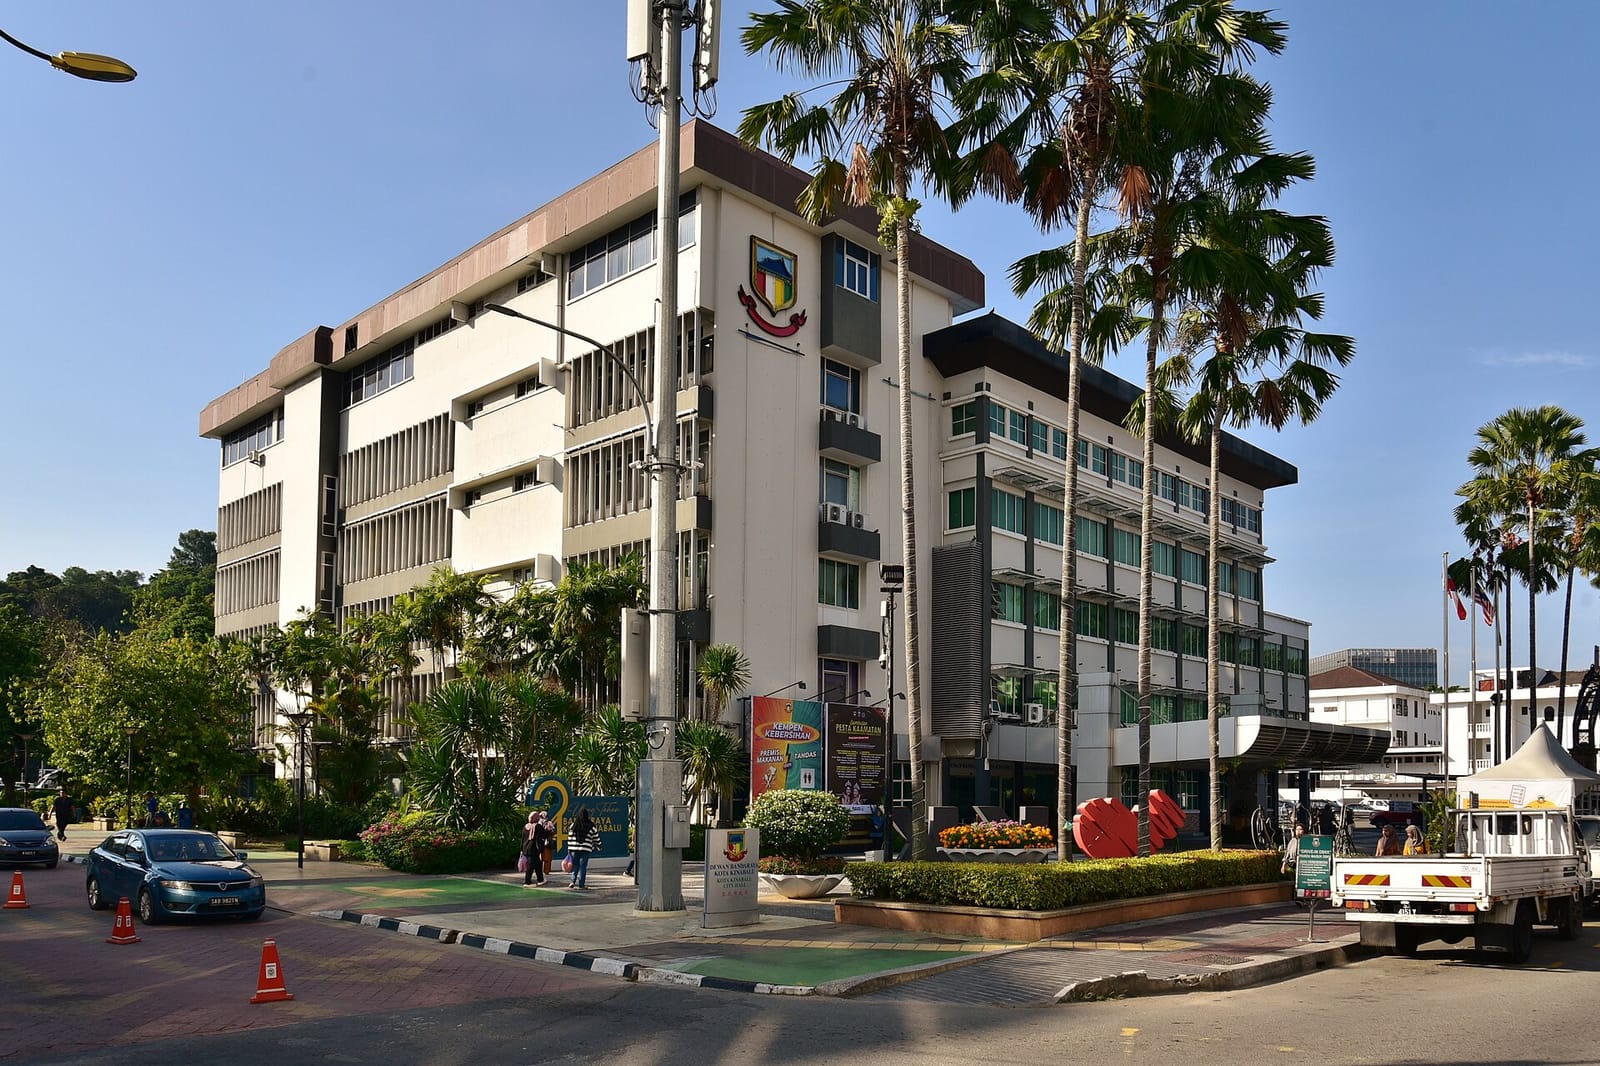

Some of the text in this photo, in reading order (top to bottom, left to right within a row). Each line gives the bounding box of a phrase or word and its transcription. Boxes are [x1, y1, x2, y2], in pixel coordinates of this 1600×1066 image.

[773, 722, 803, 732] KEMPEN
[836, 724, 851, 732] PESTA
[765, 730, 810, 740] KEBERSIHAN
[794, 751, 816, 759] TANDAS
[562, 817, 612, 826] BARAYA
